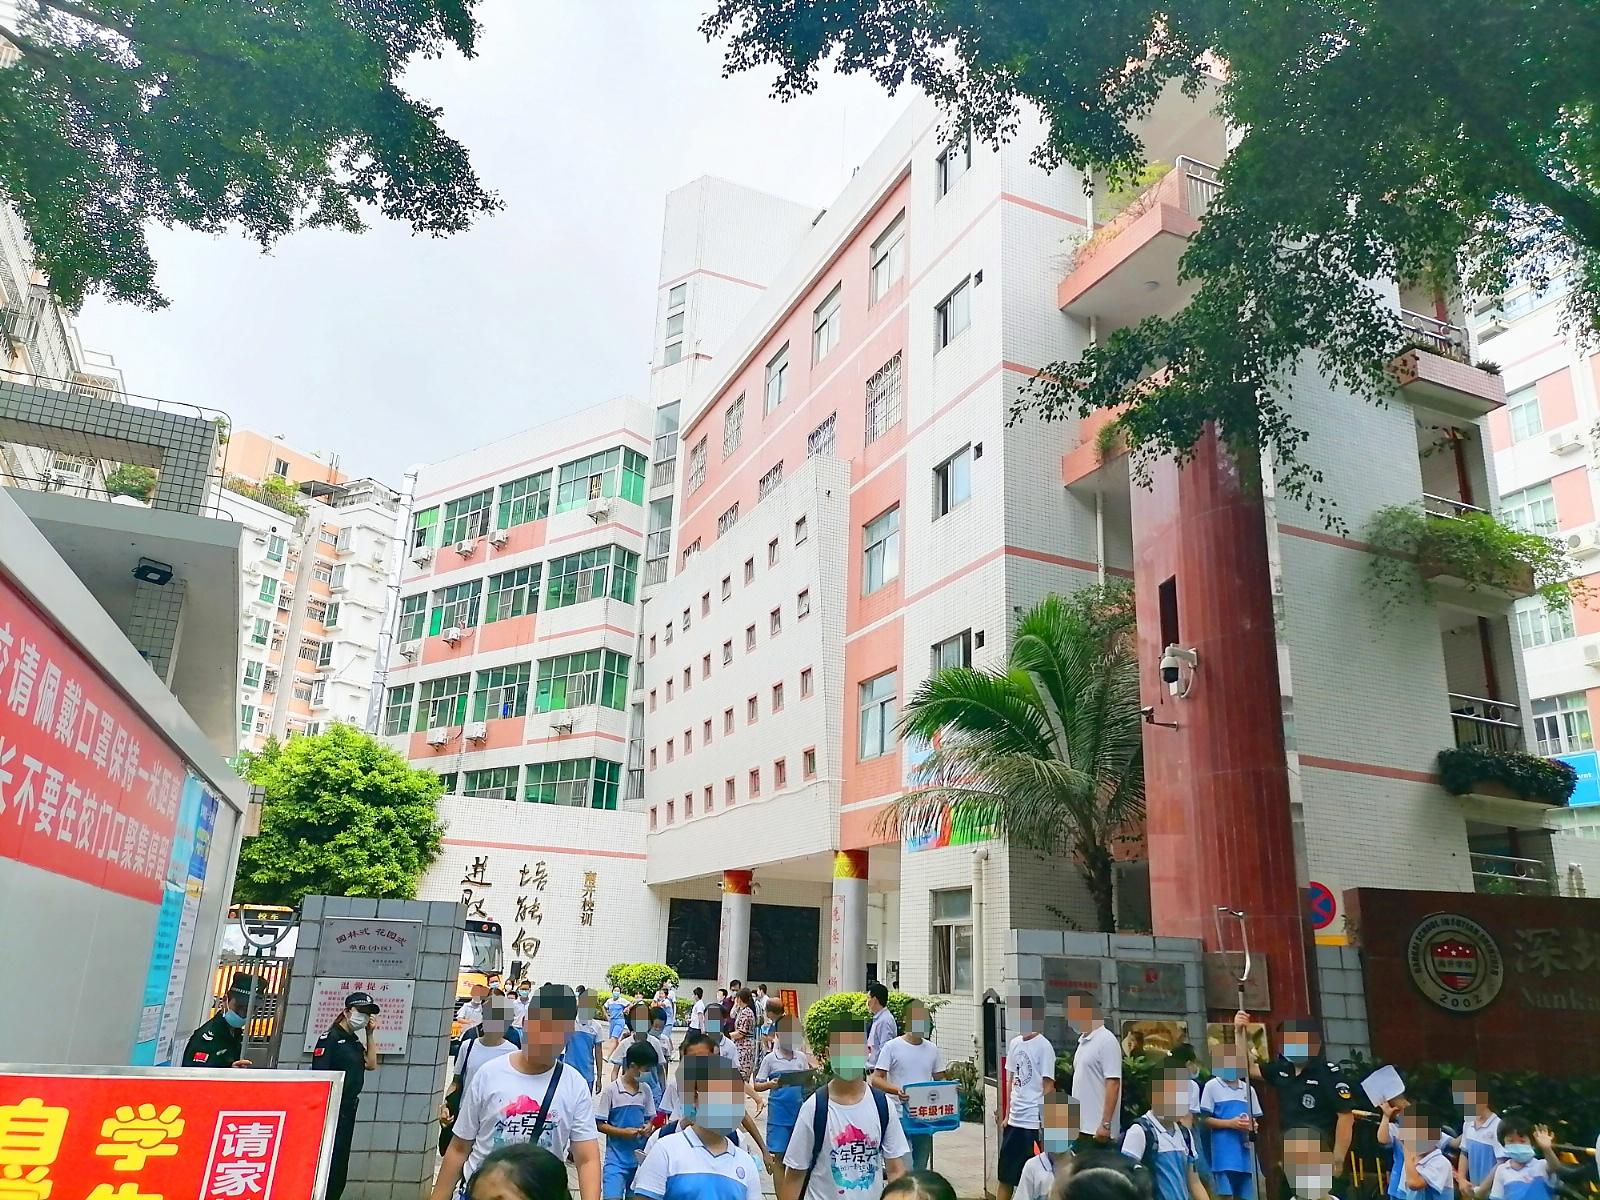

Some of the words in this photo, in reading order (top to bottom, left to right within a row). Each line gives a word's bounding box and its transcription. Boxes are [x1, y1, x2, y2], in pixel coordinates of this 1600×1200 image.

[580, 871, 597, 926] 南开校训
[257, 912, 279, 921] 校车
[340, 982, 390, 992] 温馨提示
[1440, 994, 1482, 1008] 2002
[909, 1103, 954, 1117] 三年级1班
[830, 1140, 879, 1163] 今年夏天
